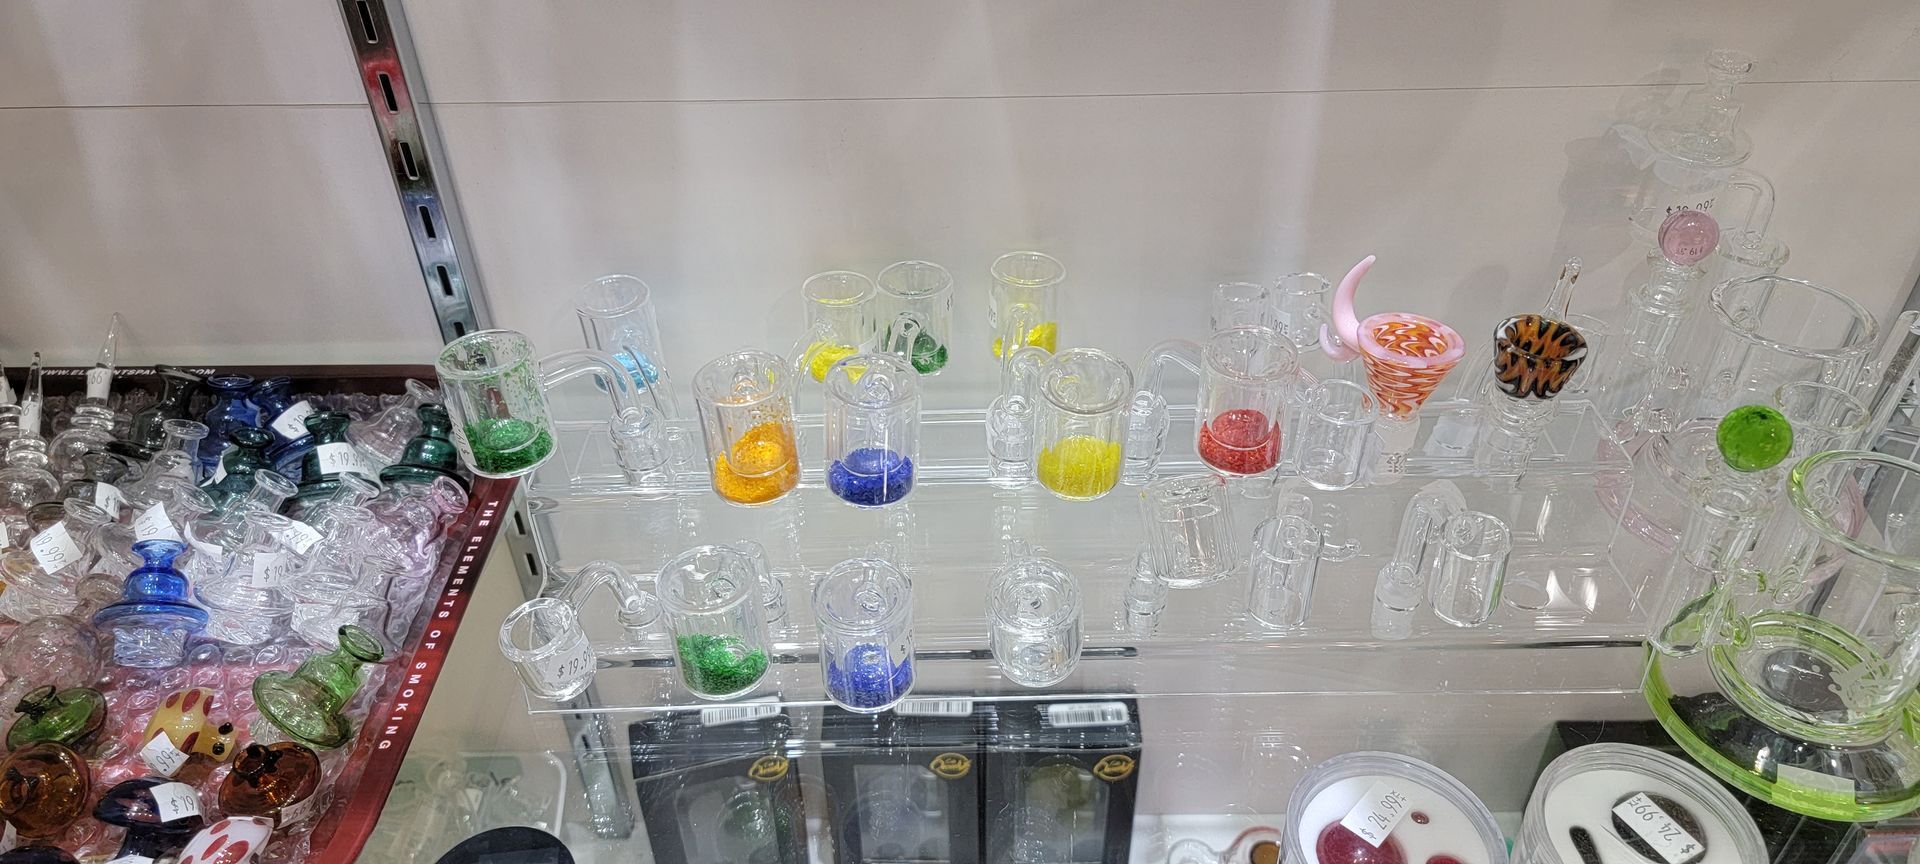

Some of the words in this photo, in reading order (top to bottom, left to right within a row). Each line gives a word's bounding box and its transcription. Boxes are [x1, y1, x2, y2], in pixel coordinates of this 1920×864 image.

[479, 500, 499, 527] THE
[438, 536, 482, 618] ELEMENTS
[425, 630, 441, 650] OF
[379, 662, 427, 750] SMOKING
